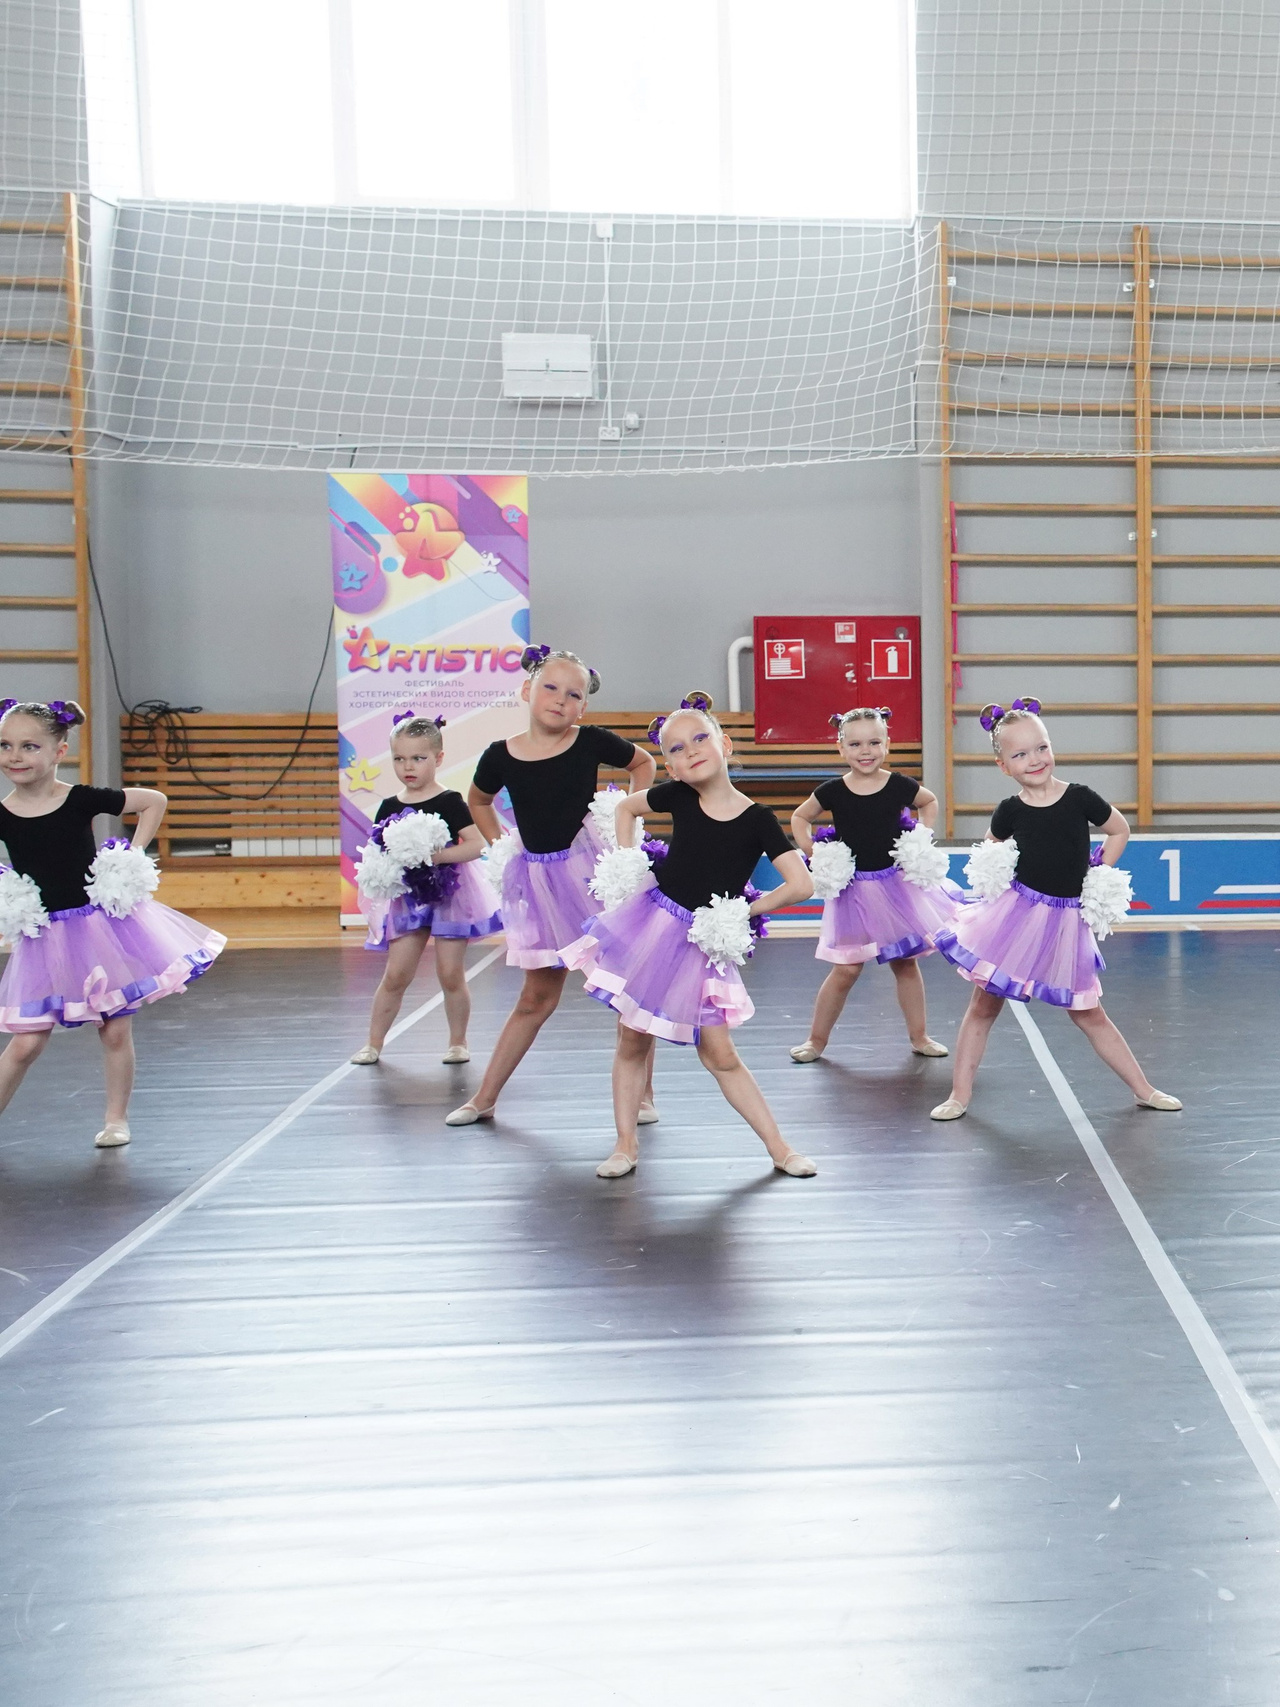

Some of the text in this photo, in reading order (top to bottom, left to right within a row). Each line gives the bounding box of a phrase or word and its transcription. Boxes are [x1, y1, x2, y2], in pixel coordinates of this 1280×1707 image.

[343, 627, 523, 673] ARTISTIC
[404, 680, 464, 688] ФЕСТИВАЛЬ
[353, 690, 516, 698] ЭСТЕТИЧЕСКИХ ВИДОВ СПОРТА И
[349, 701, 520, 709] ХОРЕОГРАФИЧЕСКОГО ИСКУССТВА
[1159, 849, 1180, 901] 1
